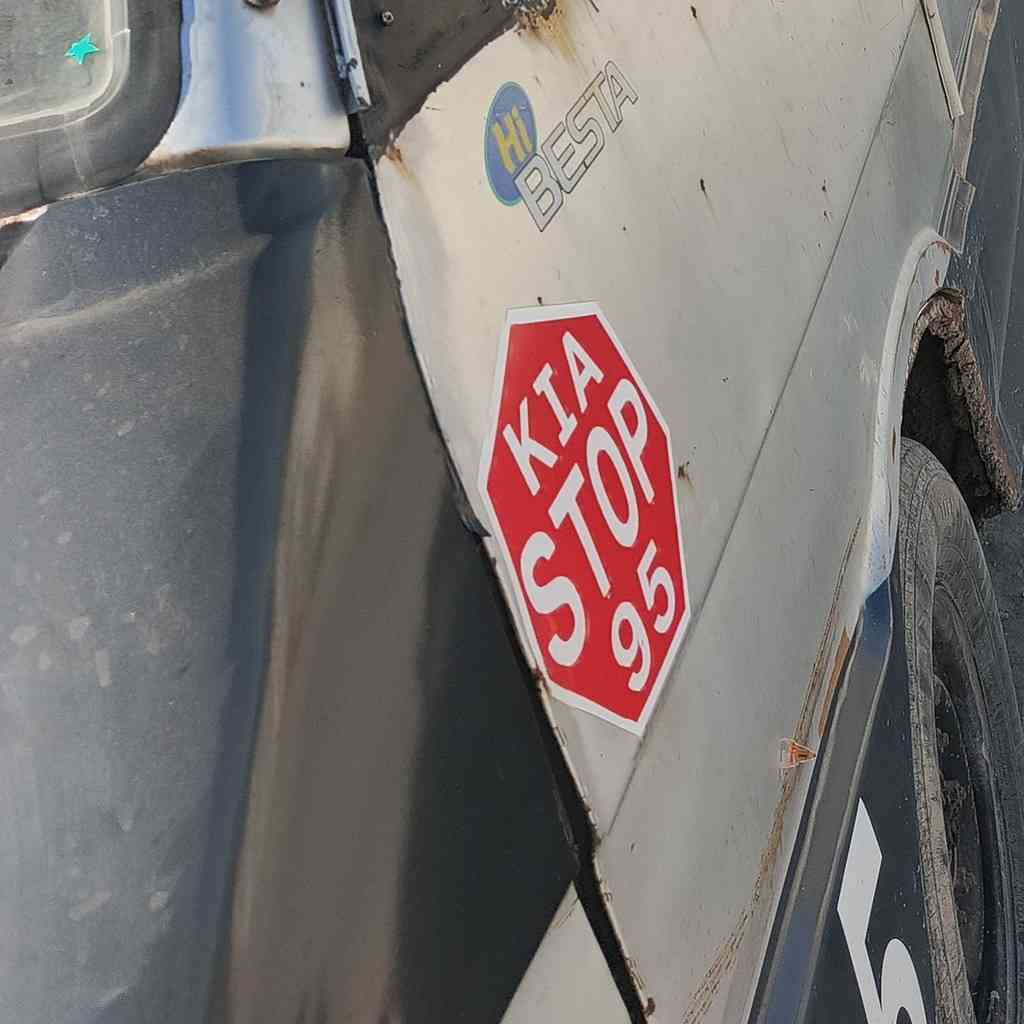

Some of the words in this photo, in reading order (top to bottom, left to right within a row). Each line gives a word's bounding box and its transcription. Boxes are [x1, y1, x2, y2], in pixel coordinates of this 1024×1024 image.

[513, 60, 639, 232] BESTA
[502, 331, 604, 496] KIA
[520, 378, 648, 667] STOP
[611, 539, 676, 692] 95
